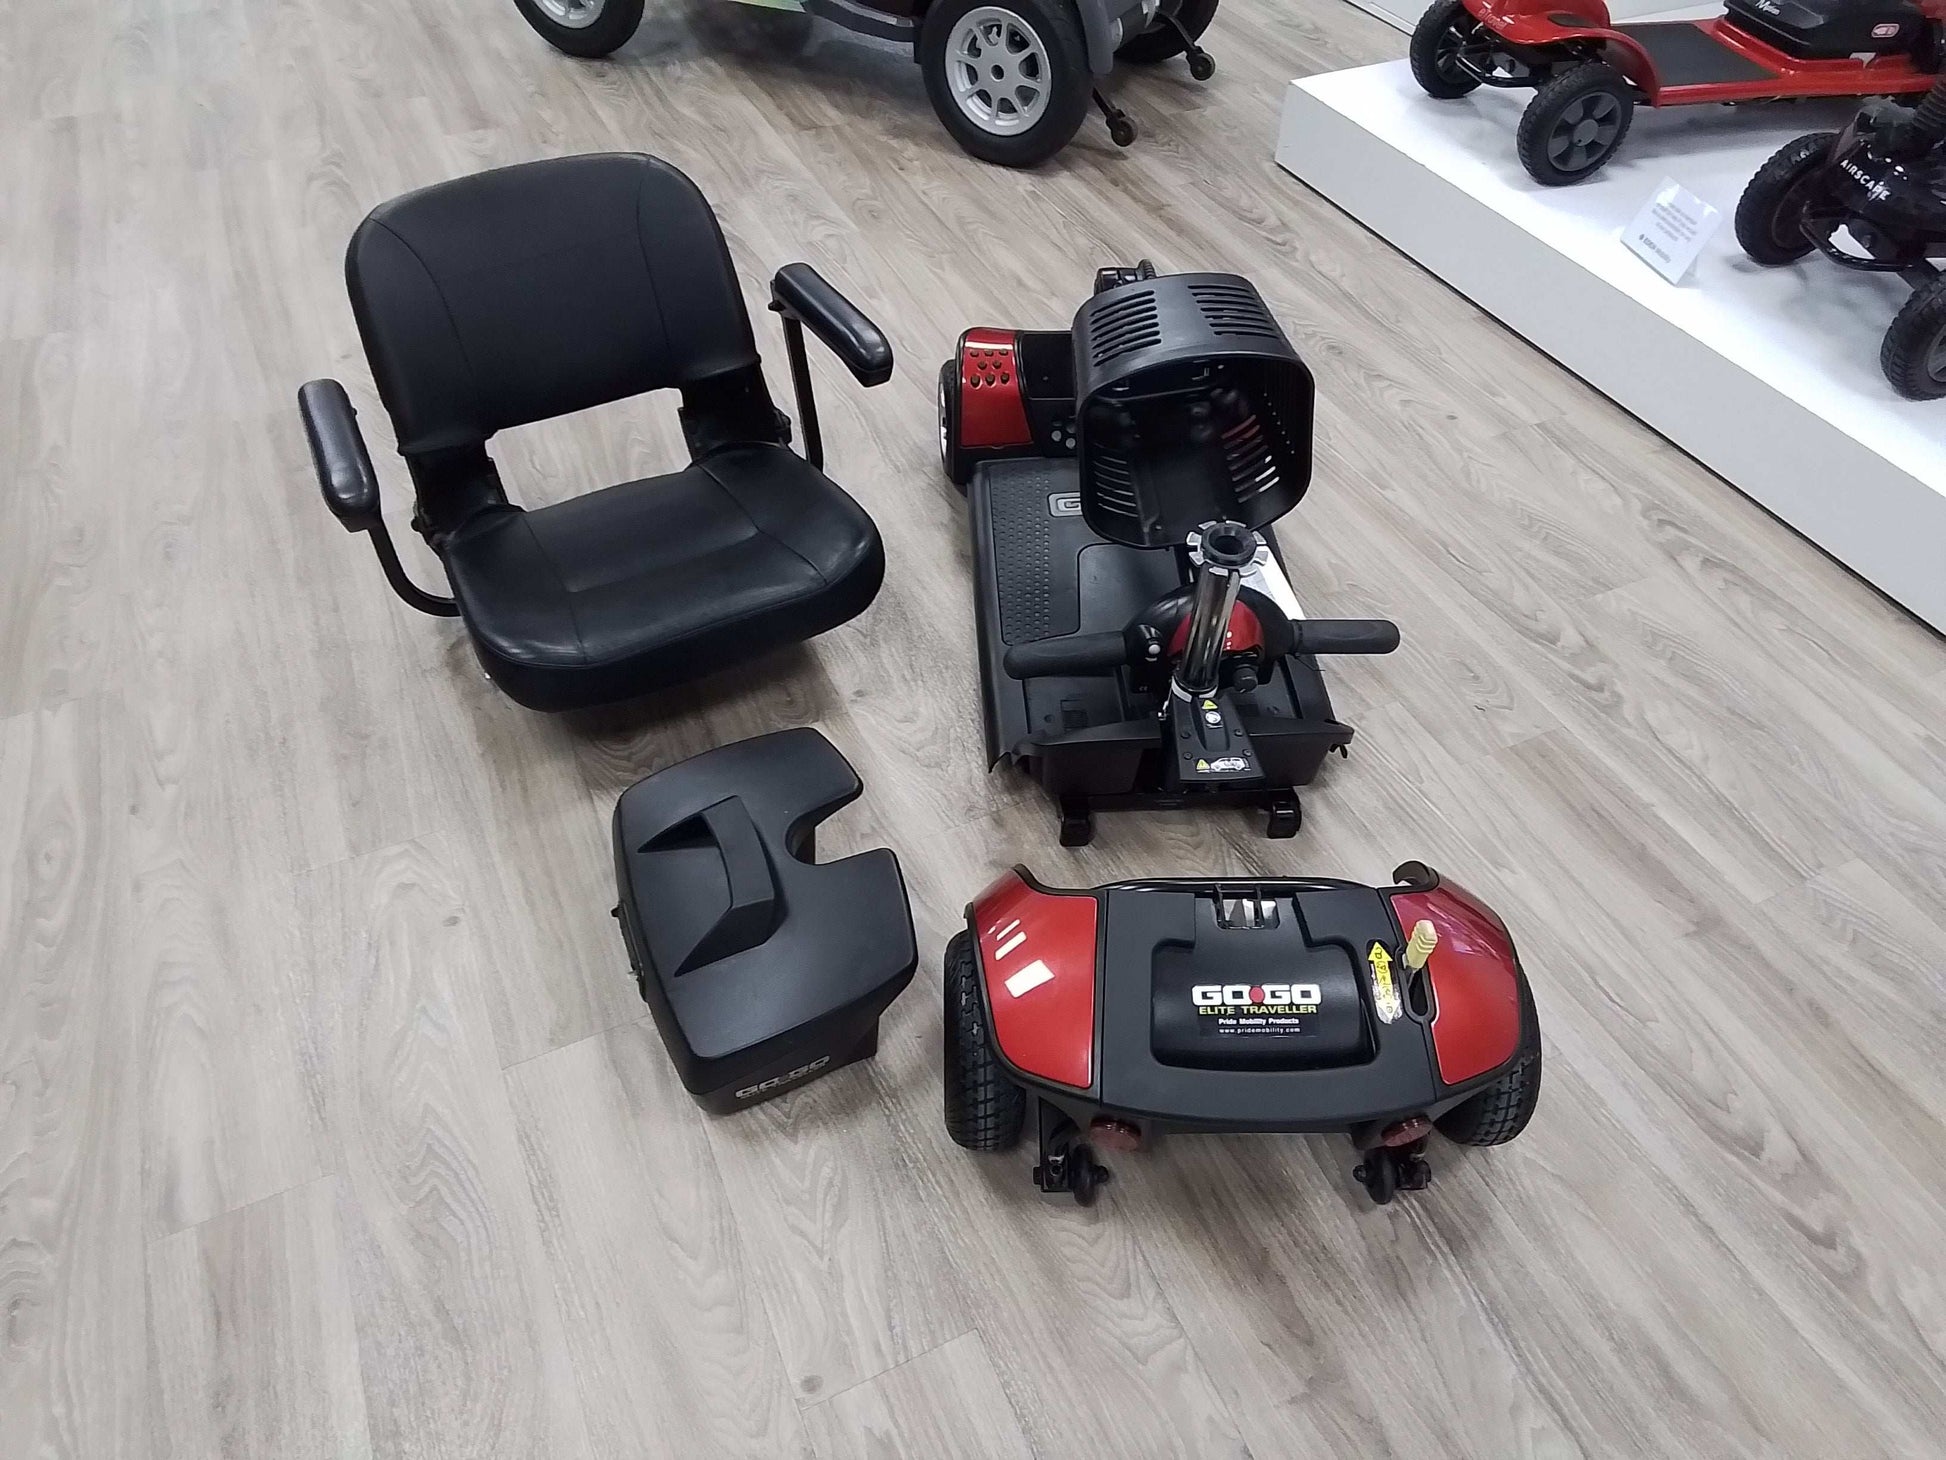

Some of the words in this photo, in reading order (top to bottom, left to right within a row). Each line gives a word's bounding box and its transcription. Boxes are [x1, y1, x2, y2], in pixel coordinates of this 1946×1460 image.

[1199, 1006, 1235, 1015] ELITE
[1241, 1005, 1317, 1014] TRAVELLER
[1239, 1018, 1266, 1026] Mobility
